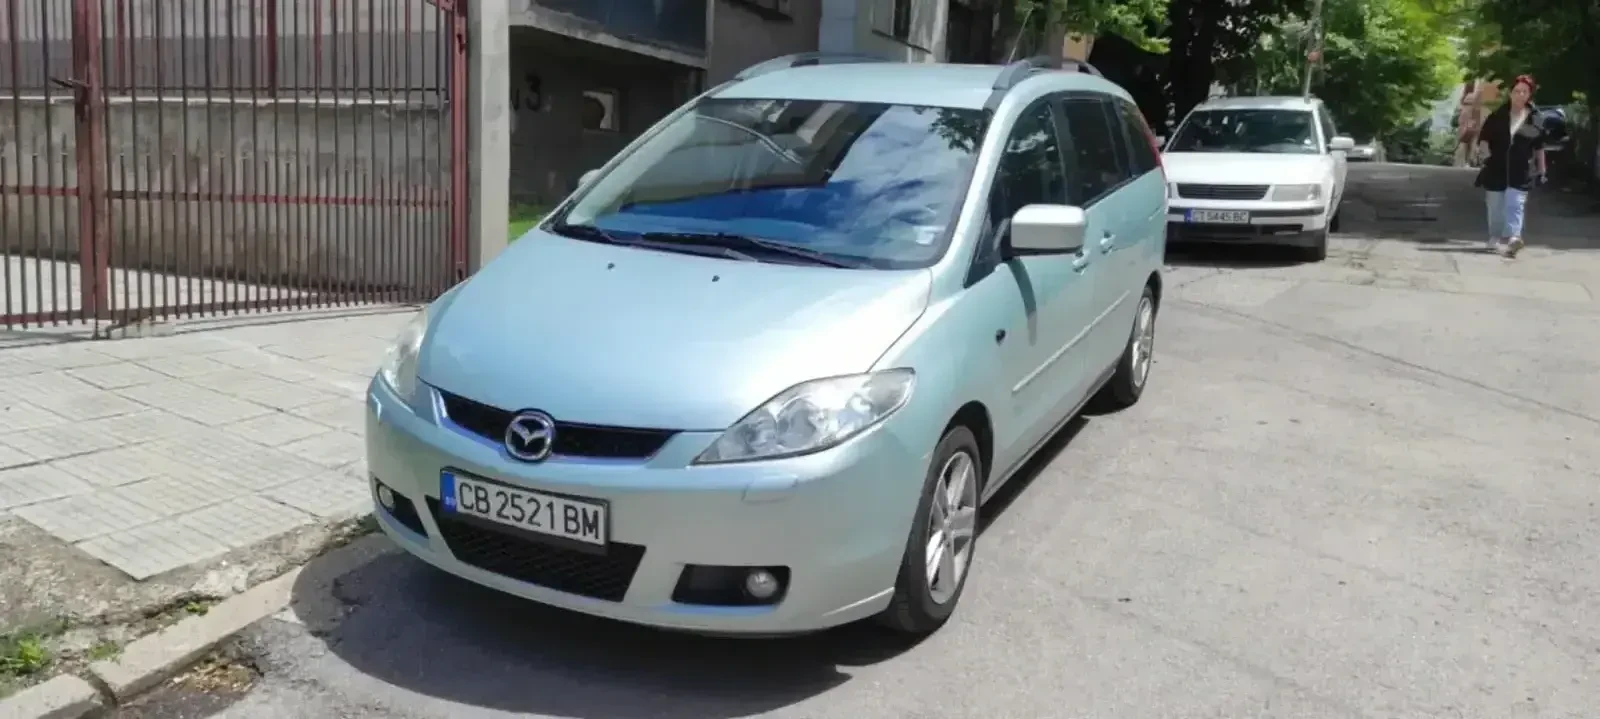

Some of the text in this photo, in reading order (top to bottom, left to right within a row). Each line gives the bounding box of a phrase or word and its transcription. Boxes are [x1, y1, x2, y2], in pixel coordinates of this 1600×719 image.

[459, 482, 600, 541] CB 2521 BM
